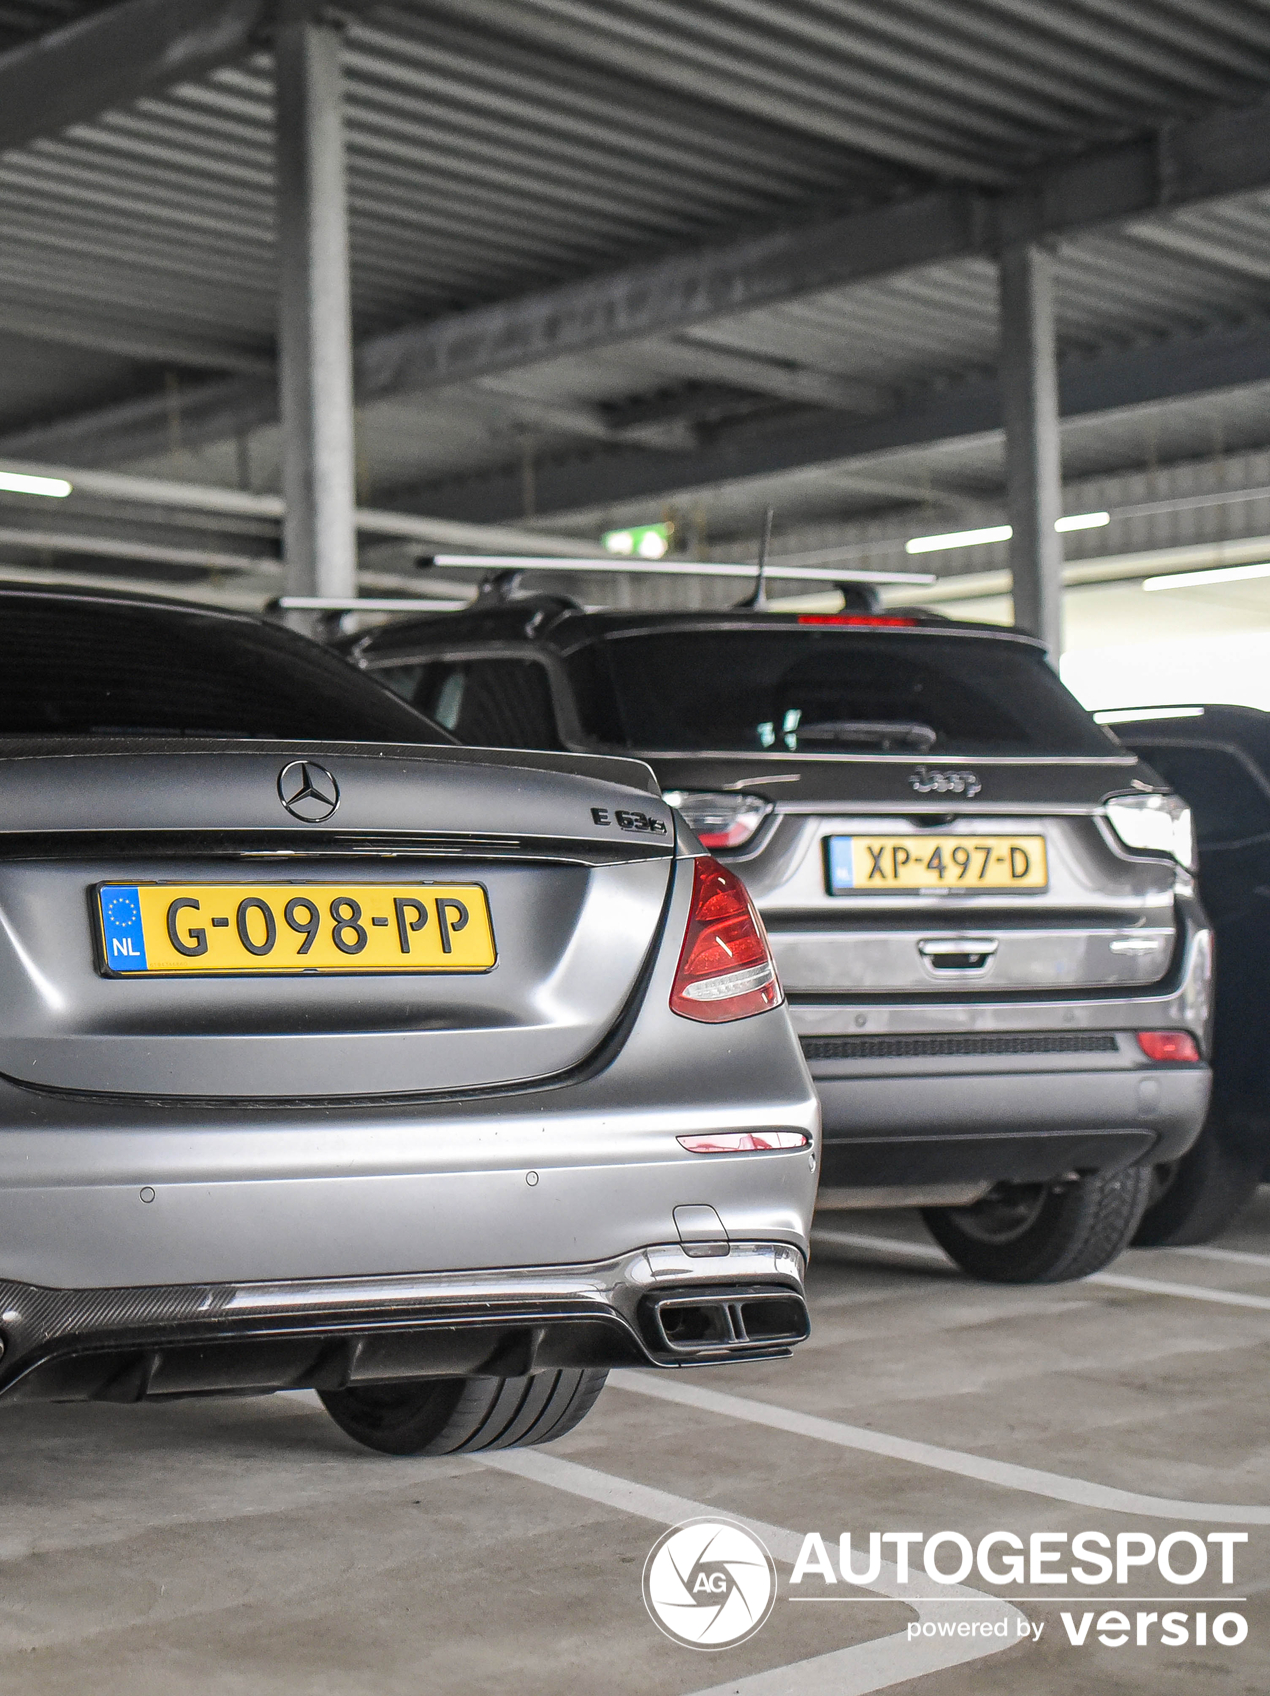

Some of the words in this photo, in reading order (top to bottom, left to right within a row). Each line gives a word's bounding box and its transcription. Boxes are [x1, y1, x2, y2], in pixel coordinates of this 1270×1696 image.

[908, 765, 982, 798] Jeep
[590, 807, 612, 827] E
[866, 845, 1031, 880] XP-497-D
[166, 896, 470, 957] G-098-PP
[113, 937, 141, 958] NL
